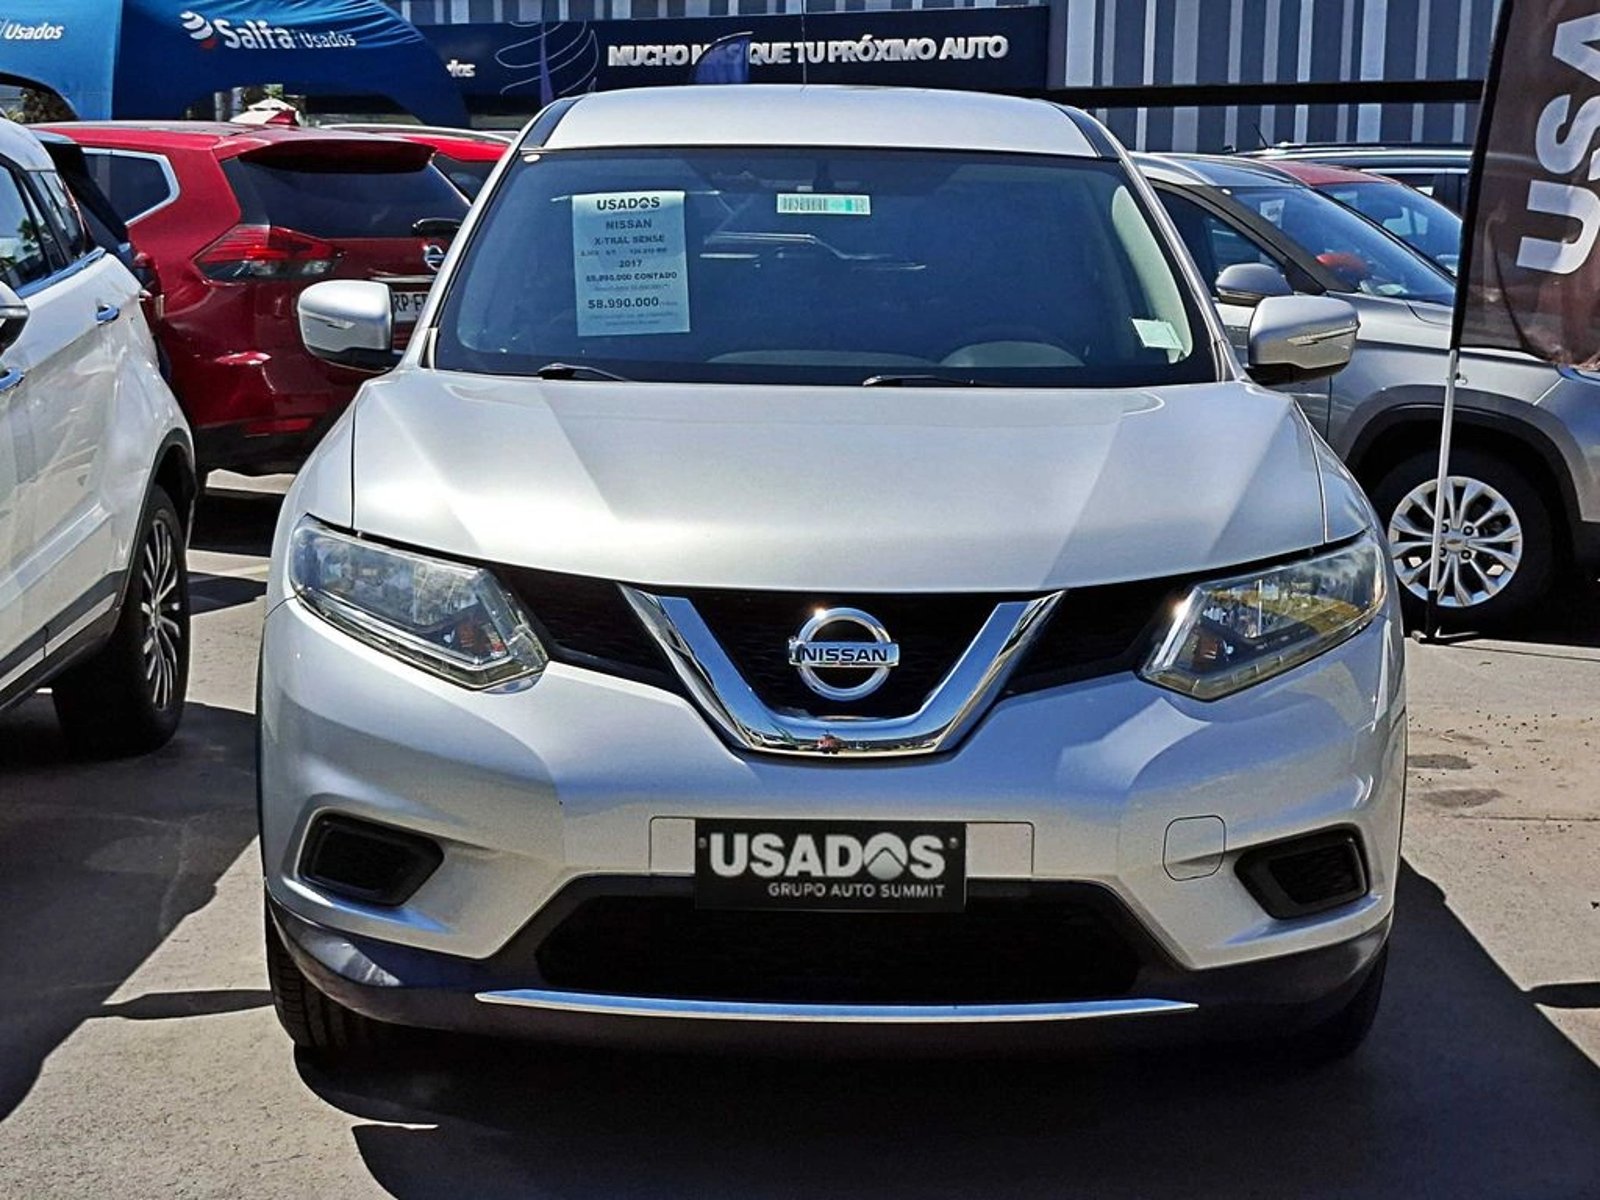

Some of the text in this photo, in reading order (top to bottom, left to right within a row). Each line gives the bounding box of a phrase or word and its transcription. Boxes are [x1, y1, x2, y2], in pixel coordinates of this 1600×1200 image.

[5, 22, 65, 40] Usados
[213, 18, 357, 50] Salfa Usados
[607, 44, 689, 66] MUCHO
[749, 42, 791, 66] QUE
[794, 41, 825, 64] TU
[827, 33, 937, 63] PRÓXIMO
[938, 35, 1009, 60] AUTO
[596, 196, 661, 211] USADOS
[606, 218, 653, 230] NISSAN
[619, 259, 643, 269] 2017
[634, 272, 677, 281] CONTADO
[801, 647, 888, 662] NISSAN
[709, 832, 946, 880] USADOS
[768, 882, 946, 898] GRUPO AUTO SUMMIT
